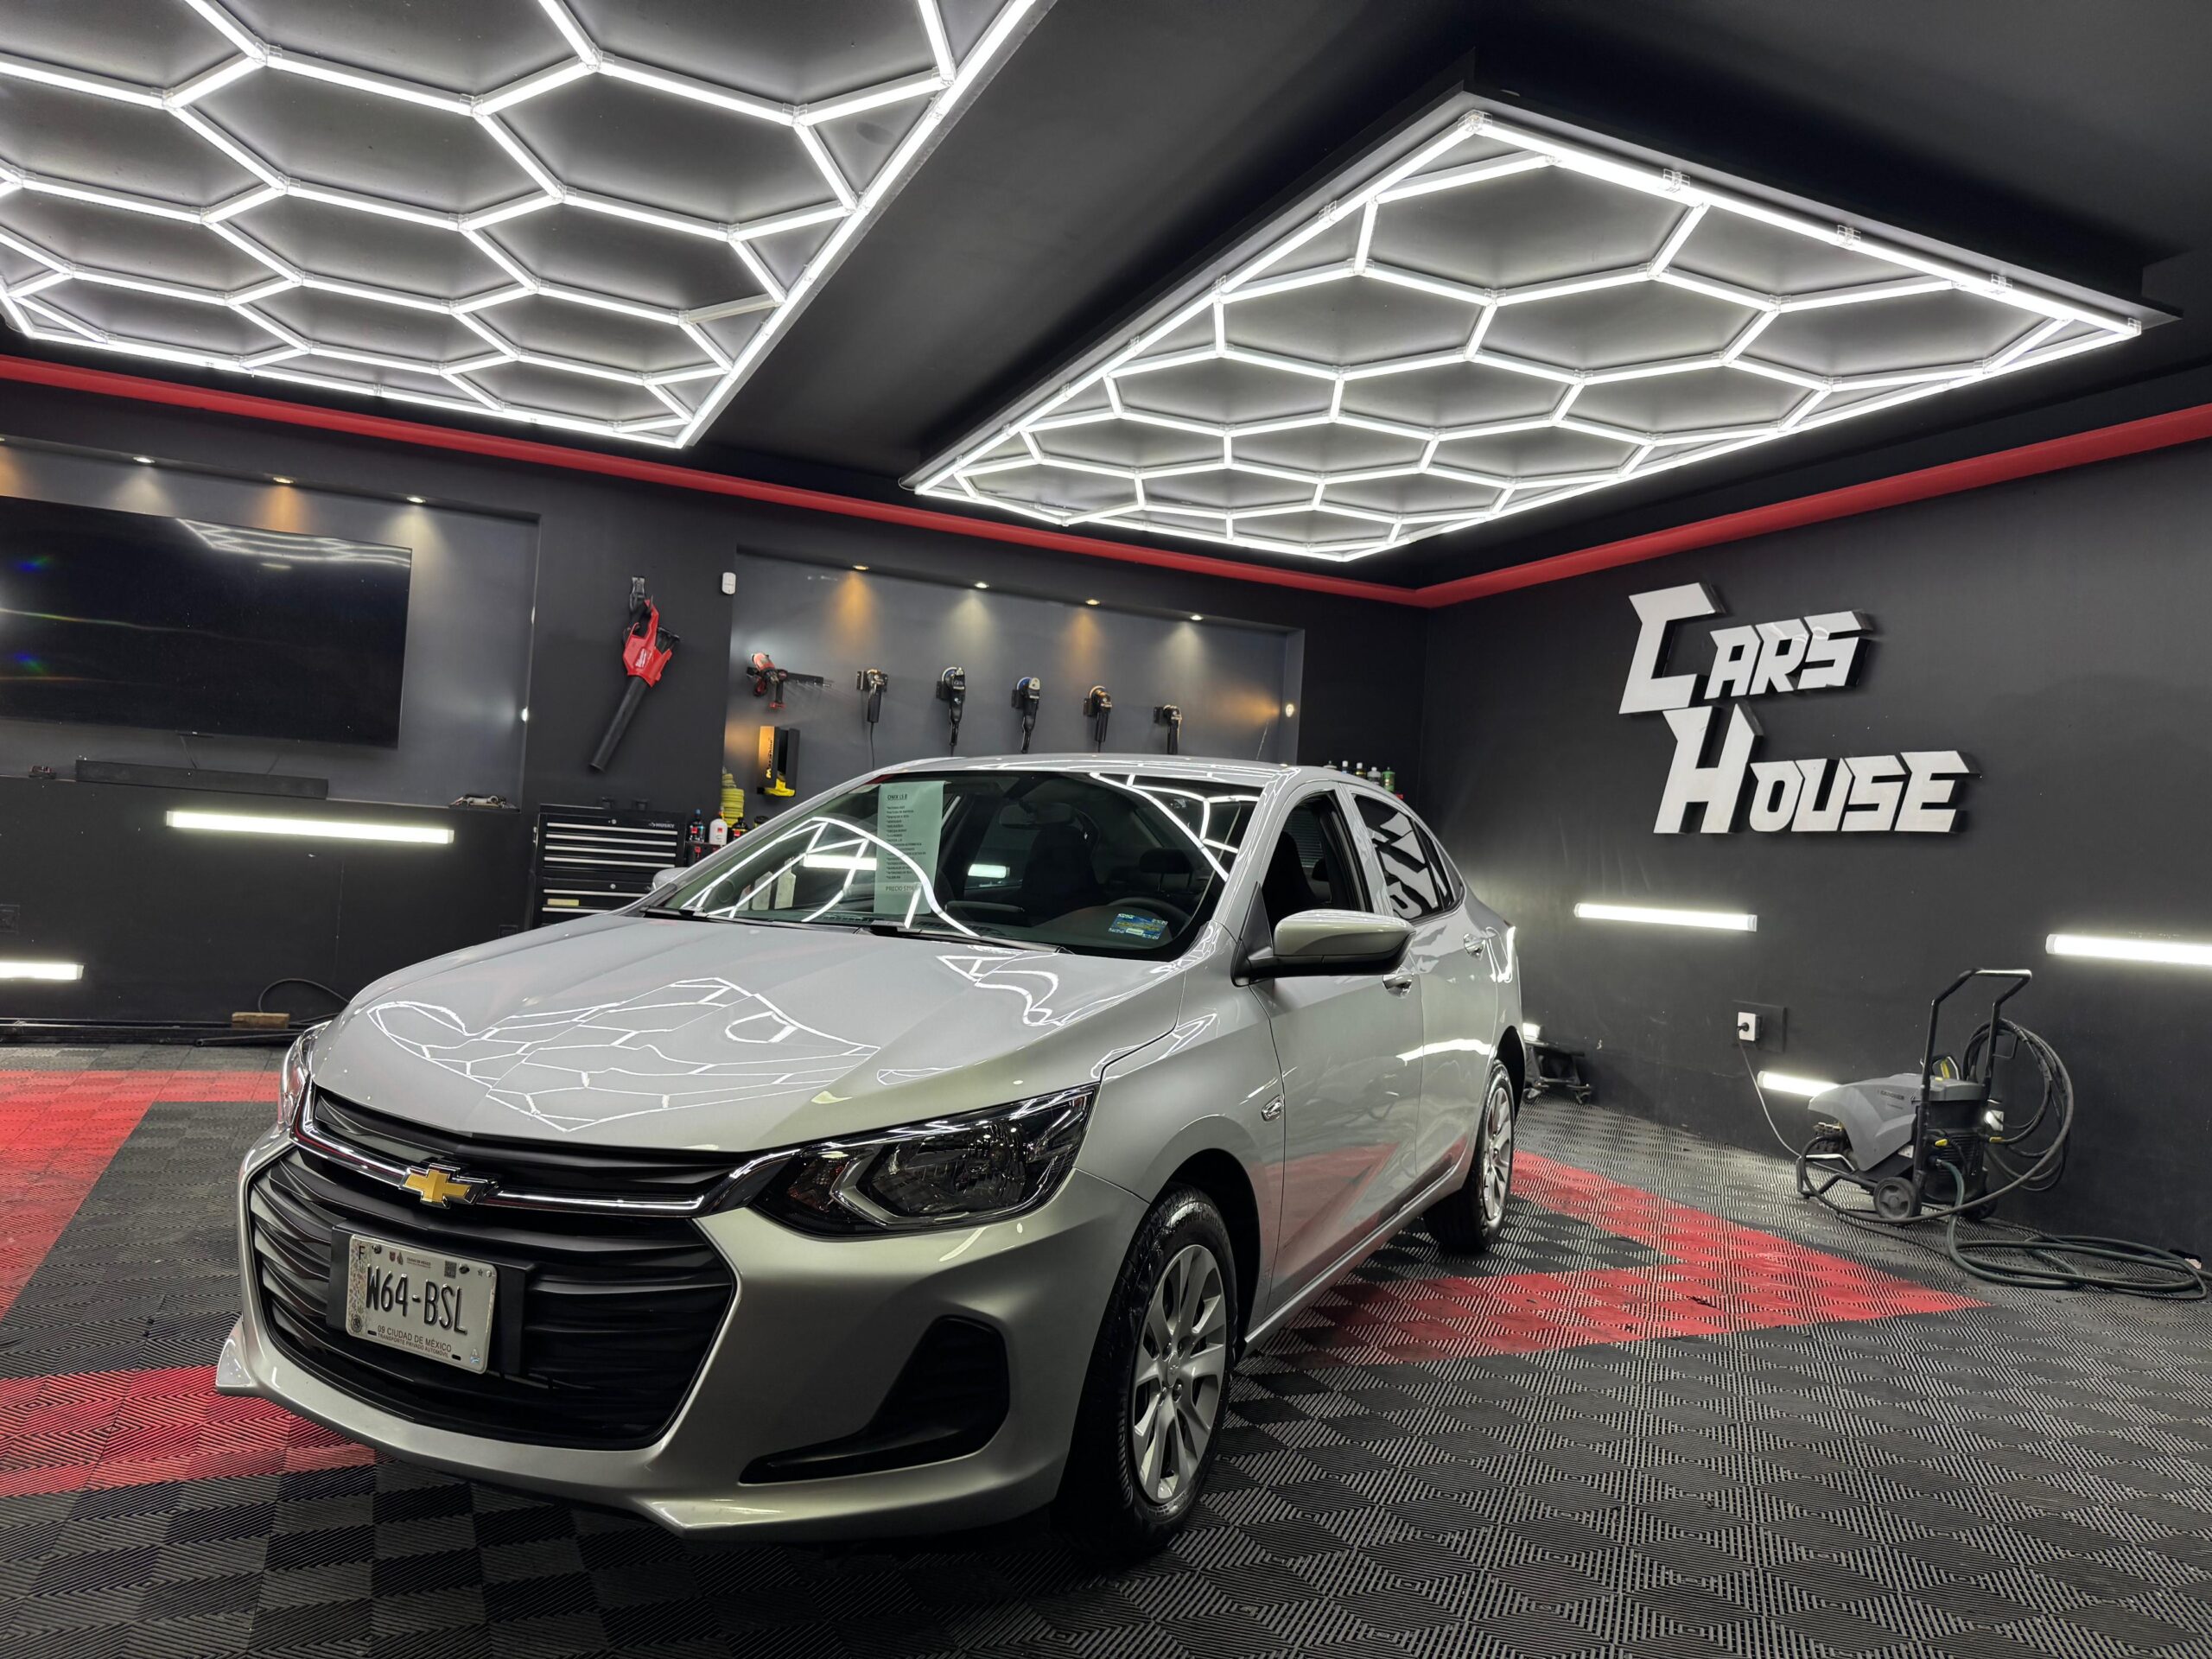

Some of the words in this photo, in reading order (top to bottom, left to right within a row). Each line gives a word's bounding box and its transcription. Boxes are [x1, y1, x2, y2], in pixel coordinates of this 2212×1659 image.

[1653, 703, 1970, 834] HOUSE
[365, 1263, 468, 1336] W64-BSL
[378, 1332, 405, 1344] TRANSPORTE
[378, 1325, 385, 1334] 09
[386, 1327, 413, 1341] CIUDAD
[414, 1335, 423, 1344] DE
[425, 1338, 452, 1353] MÉXICO
